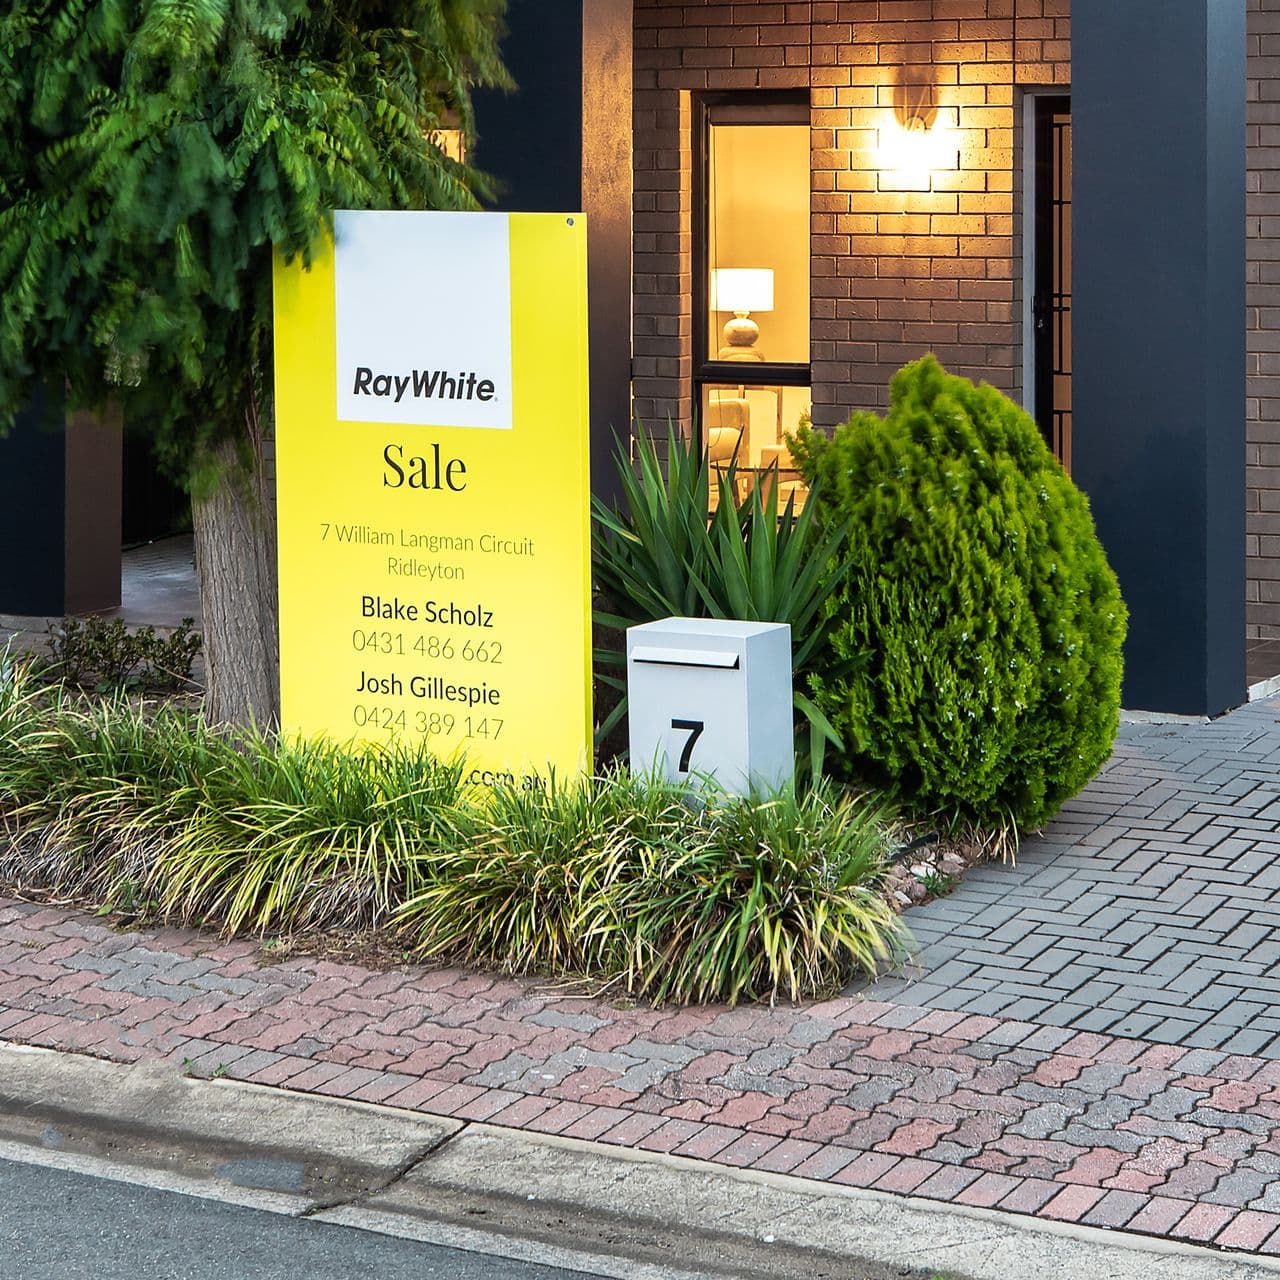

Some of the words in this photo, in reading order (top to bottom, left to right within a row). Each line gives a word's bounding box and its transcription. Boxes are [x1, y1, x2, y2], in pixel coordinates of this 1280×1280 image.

[383, 443, 467, 491] Sale
[320, 523, 330, 541] 7
[335, 524, 394, 545] William
[401, 529, 473, 553] Langman
[479, 534, 535, 556] Circuit
[388, 557, 465, 581] Ridleyton
[362, 595, 418, 621] Blake
[425, 601, 493, 628] Scholz
[352, 629, 406, 655] 0431
[413, 635, 455, 660] 486
[462, 639, 503, 664] 662
[356, 671, 403, 696] Josh
[410, 676, 501, 707] Gillespie
[353, 704, 408, 731] 0424
[415, 711, 455, 736] 389
[464, 716, 504, 740] 147
[671, 719, 704, 773] 7
